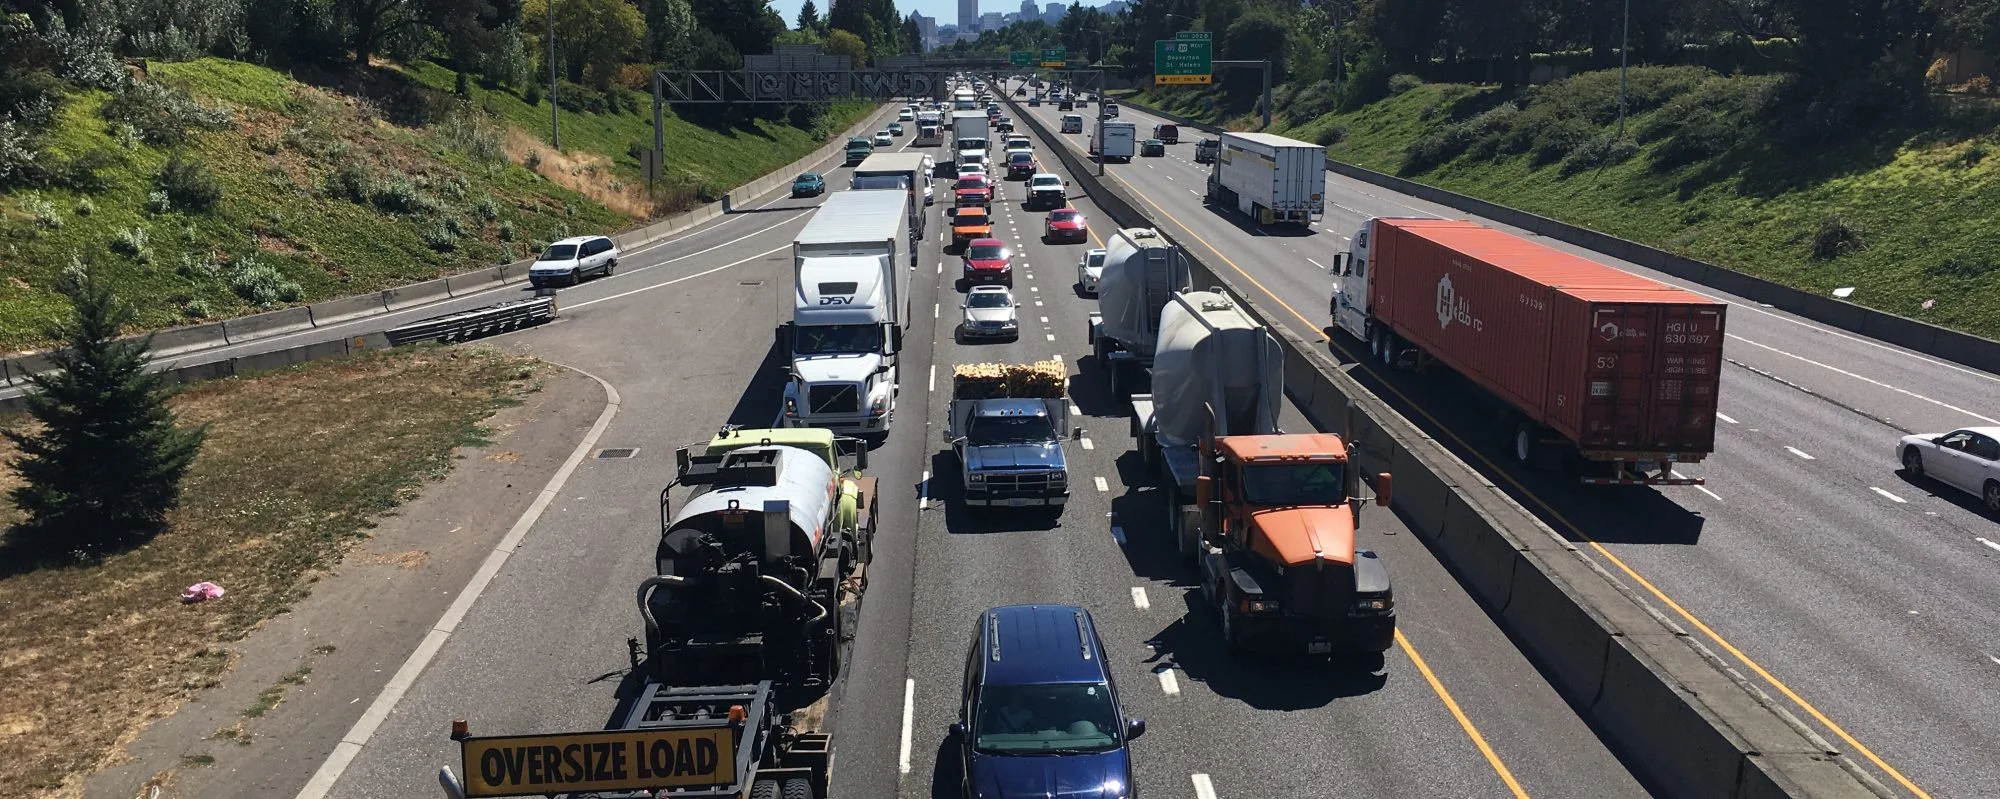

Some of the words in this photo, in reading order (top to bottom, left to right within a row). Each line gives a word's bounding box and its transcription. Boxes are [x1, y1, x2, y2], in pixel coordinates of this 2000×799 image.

[819, 296, 854, 305] DSV
[1666, 358, 1706, 366] WARING
[480, 741, 628, 787] OVERSIZE
[636, 737, 719, 779] LOAD
